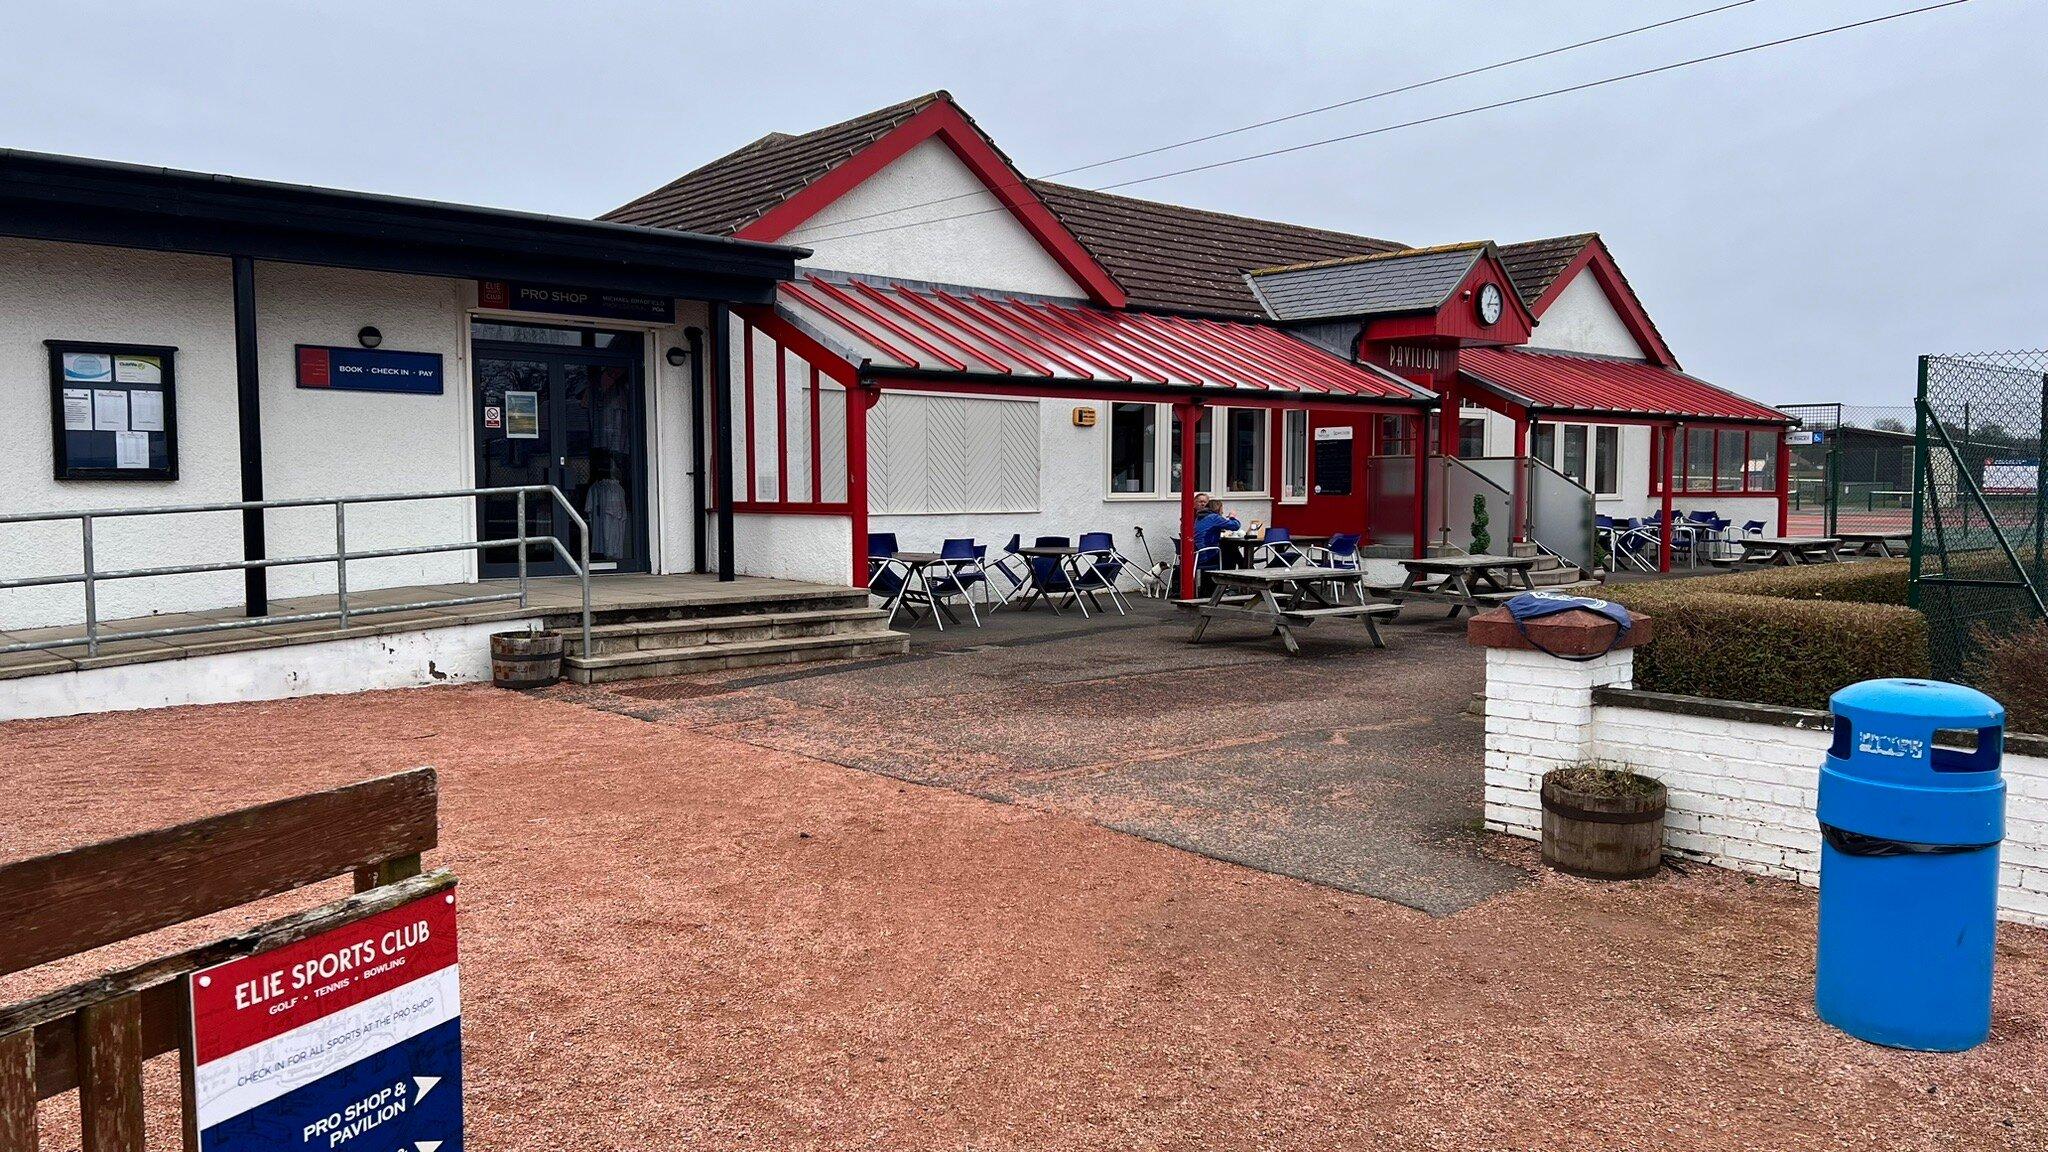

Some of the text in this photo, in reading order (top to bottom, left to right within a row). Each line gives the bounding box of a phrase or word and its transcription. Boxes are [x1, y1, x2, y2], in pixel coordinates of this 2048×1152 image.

[520, 288, 588, 303] PRO SHOP
[339, 365, 363, 373] BOOK
[371, 367, 399, 375] CHECK
[1389, 345, 1440, 370] PAVILION
[235, 920, 430, 1011] ELIE SPORTS CLUB
[269, 957, 405, 1015] GOLF TENNIS BOWLING
[237, 997, 434, 1087] CHECK IN FOR ALL SPORTS AT THE PRO SHOP
[303, 1082, 407, 1142] PRO SHOP &
[329, 1099, 407, 1148] PAVILION
